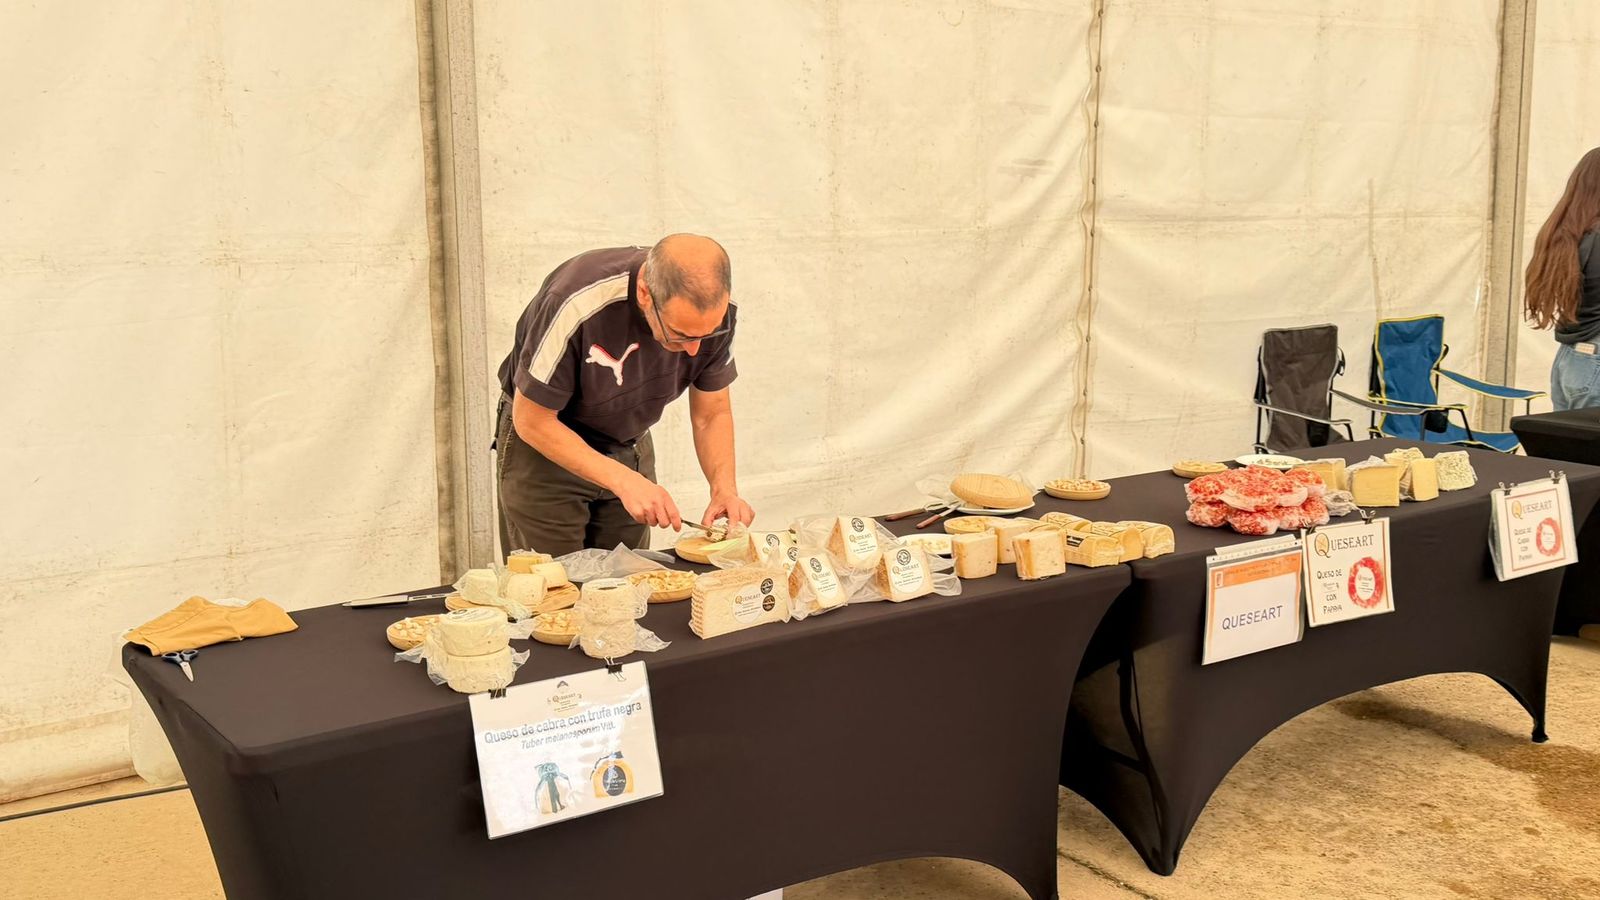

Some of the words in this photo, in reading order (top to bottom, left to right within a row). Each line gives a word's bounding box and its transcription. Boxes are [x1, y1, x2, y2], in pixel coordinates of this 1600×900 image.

[1511, 500, 1552, 519] QUESEART
[1314, 532, 1375, 558] QUESEART
[1317, 570, 1334, 579] QUESO
[1222, 605, 1283, 630] QUESEART
[485, 729, 519, 744] Queso
[521, 724, 535, 736] de
[536, 718, 566, 735] cabra
[568, 714, 587, 727] con
[587, 706, 612, 721] trufa
[613, 702, 642, 716] negra
[521, 736, 544, 750] Tuber
[545, 726, 601, 745] melanosporum
